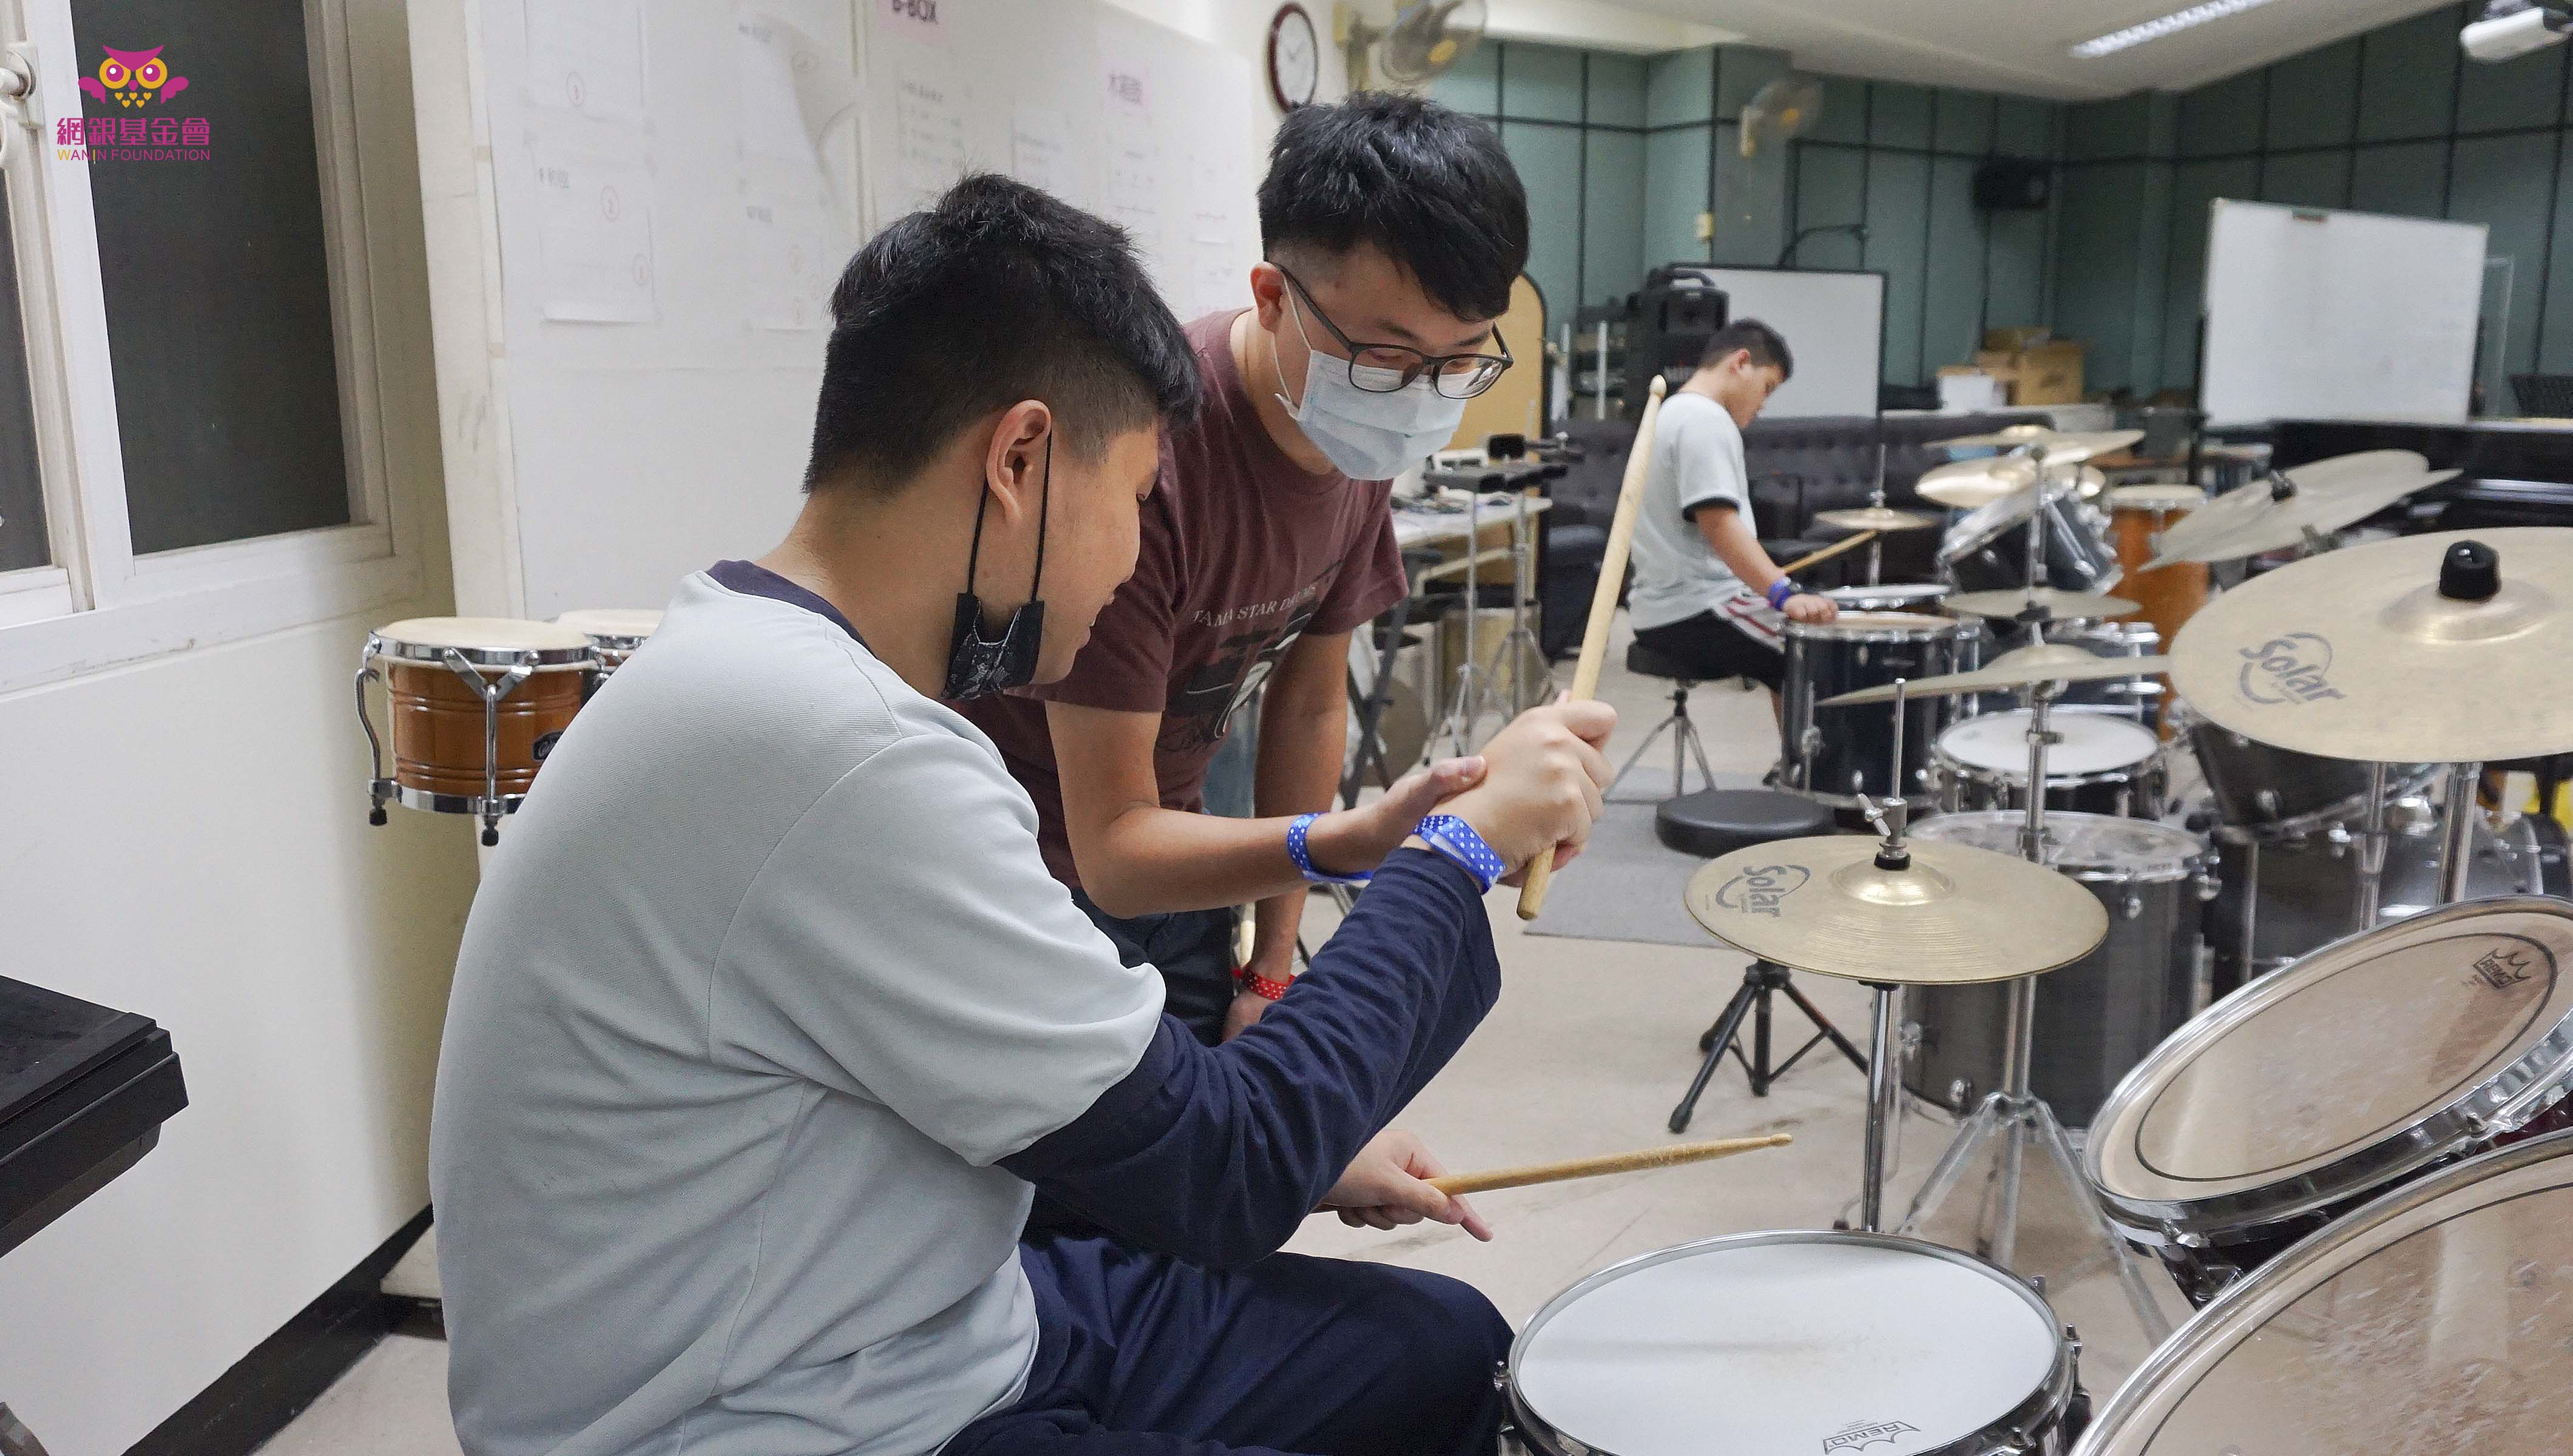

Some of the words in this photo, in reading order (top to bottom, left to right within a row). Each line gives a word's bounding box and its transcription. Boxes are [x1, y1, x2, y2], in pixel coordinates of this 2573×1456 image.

[1237, 601, 1277, 619] STAR
[2239, 640, 2347, 701] Solar
[1743, 865, 1787, 917] Solar
[2480, 958, 2513, 984] REMO
[1831, 1424, 1901, 1446] REMO
